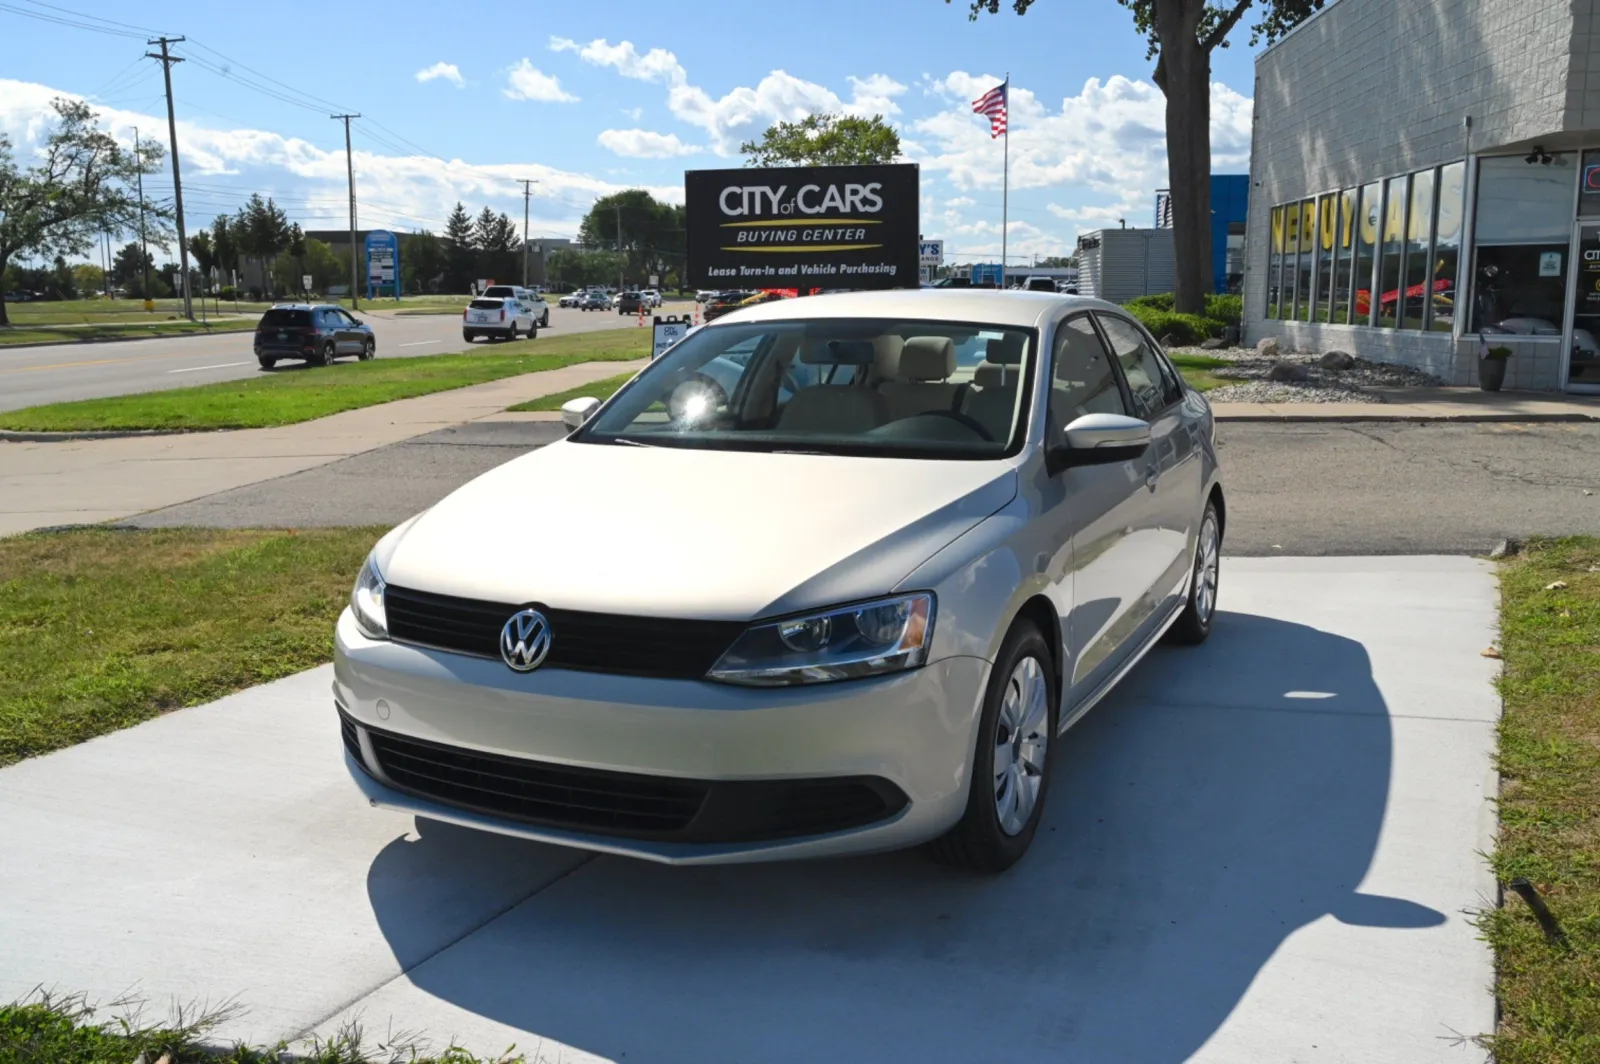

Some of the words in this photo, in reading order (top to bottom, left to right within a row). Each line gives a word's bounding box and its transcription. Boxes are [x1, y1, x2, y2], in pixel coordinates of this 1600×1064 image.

[719, 185, 788, 216] CITY
[780, 198, 796, 214] of
[796, 182, 884, 214] CARS
[1301, 195, 1355, 253] BUY
[1360, 166, 1465, 245] CARS
[737, 230, 797, 242] BUYING
[802, 228, 866, 241] CENTER
[708, 266, 737, 277] Lease
[778, 264, 798, 275] and
[801, 263, 837, 275] Vehicle
[840, 262, 897, 276] Purchasing
